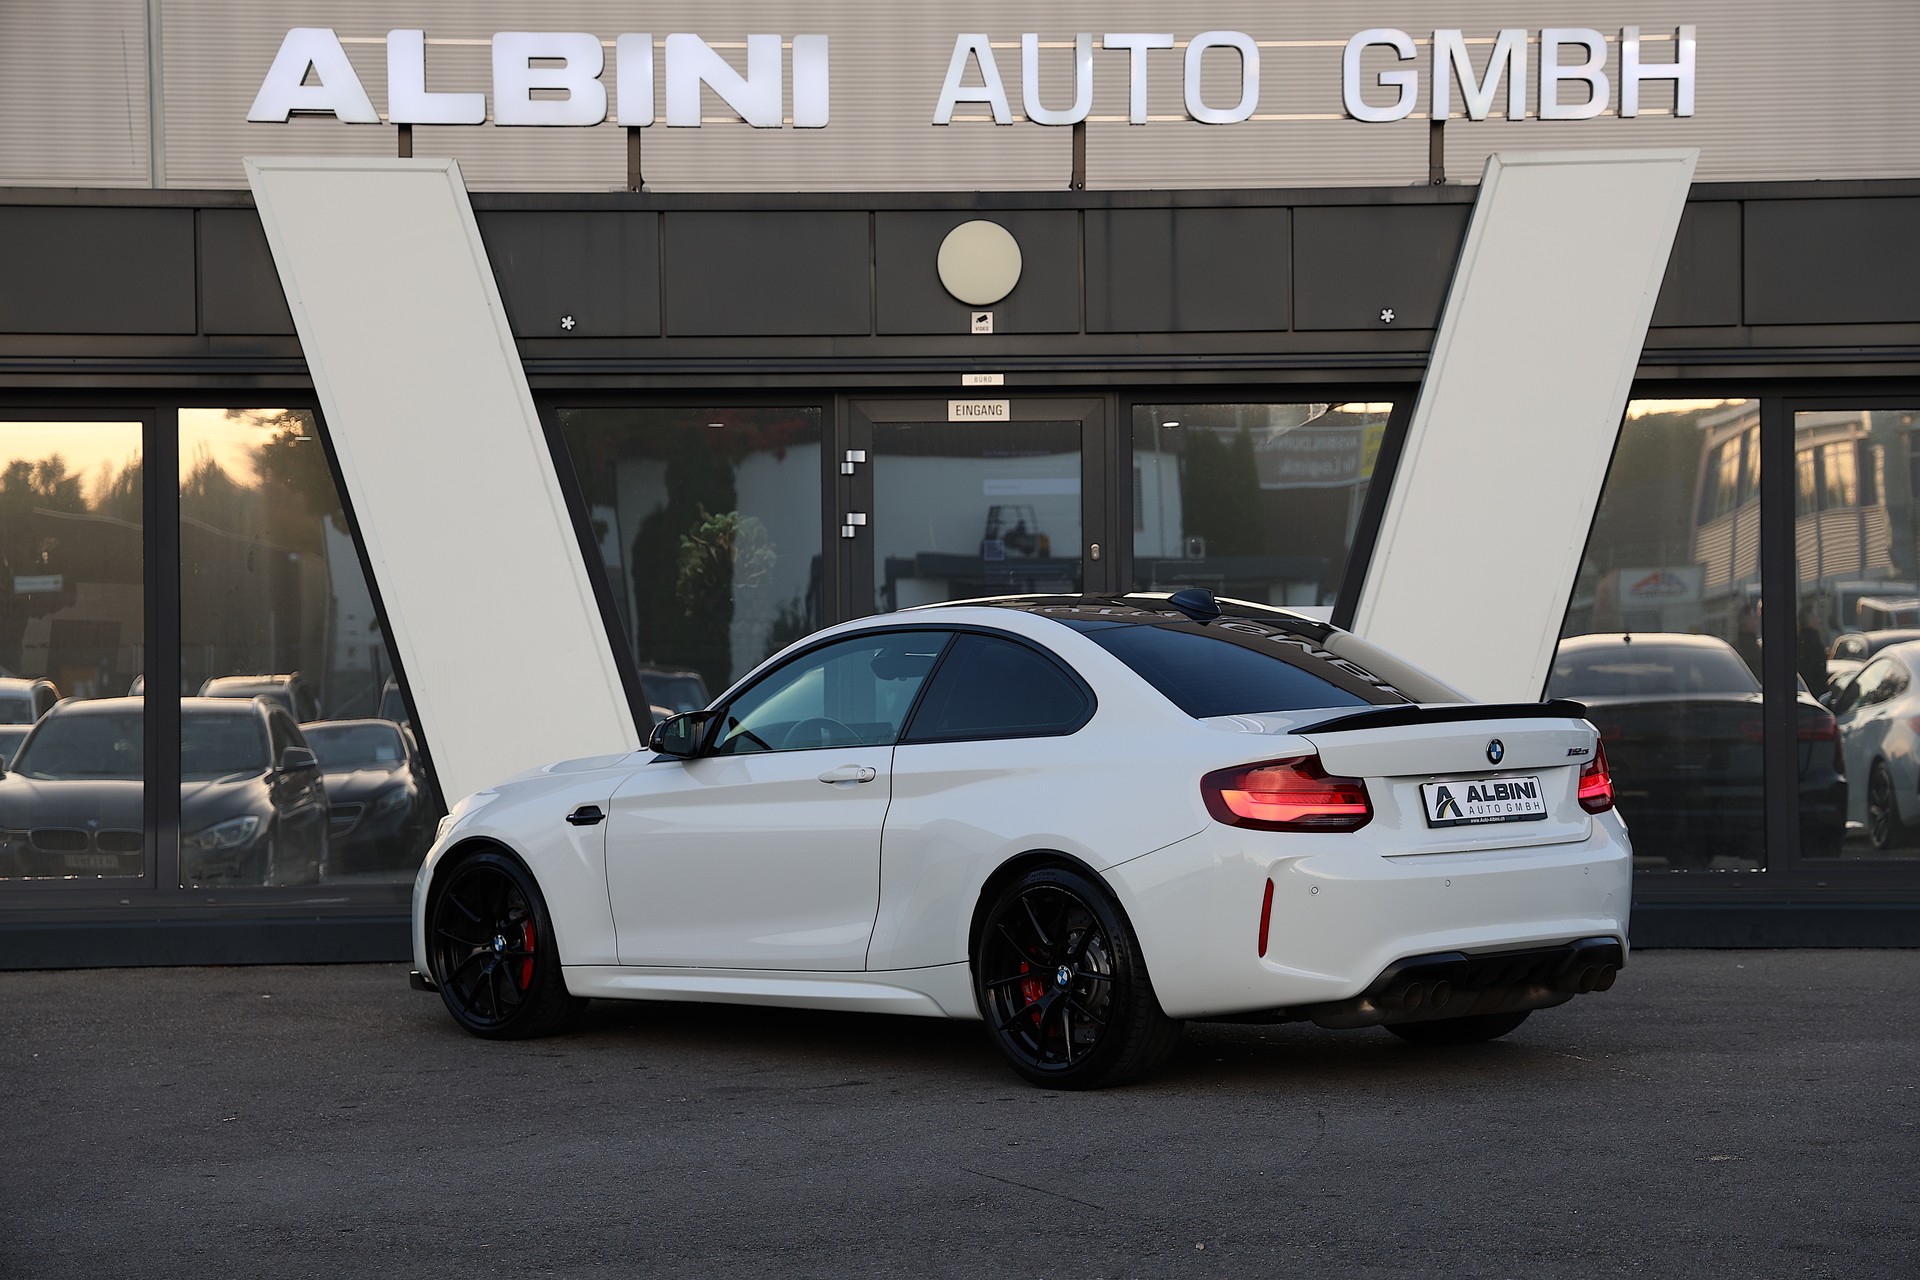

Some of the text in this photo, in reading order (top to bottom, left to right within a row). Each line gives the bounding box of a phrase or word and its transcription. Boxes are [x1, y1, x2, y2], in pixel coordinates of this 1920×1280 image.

[247, 25, 1697, 129] ALBINI AUTO GMBH
[955, 404, 1003, 416] EINGANG
[1466, 781, 1538, 803] ALBINI
[1469, 801, 1541, 815] AUTO GMBH
